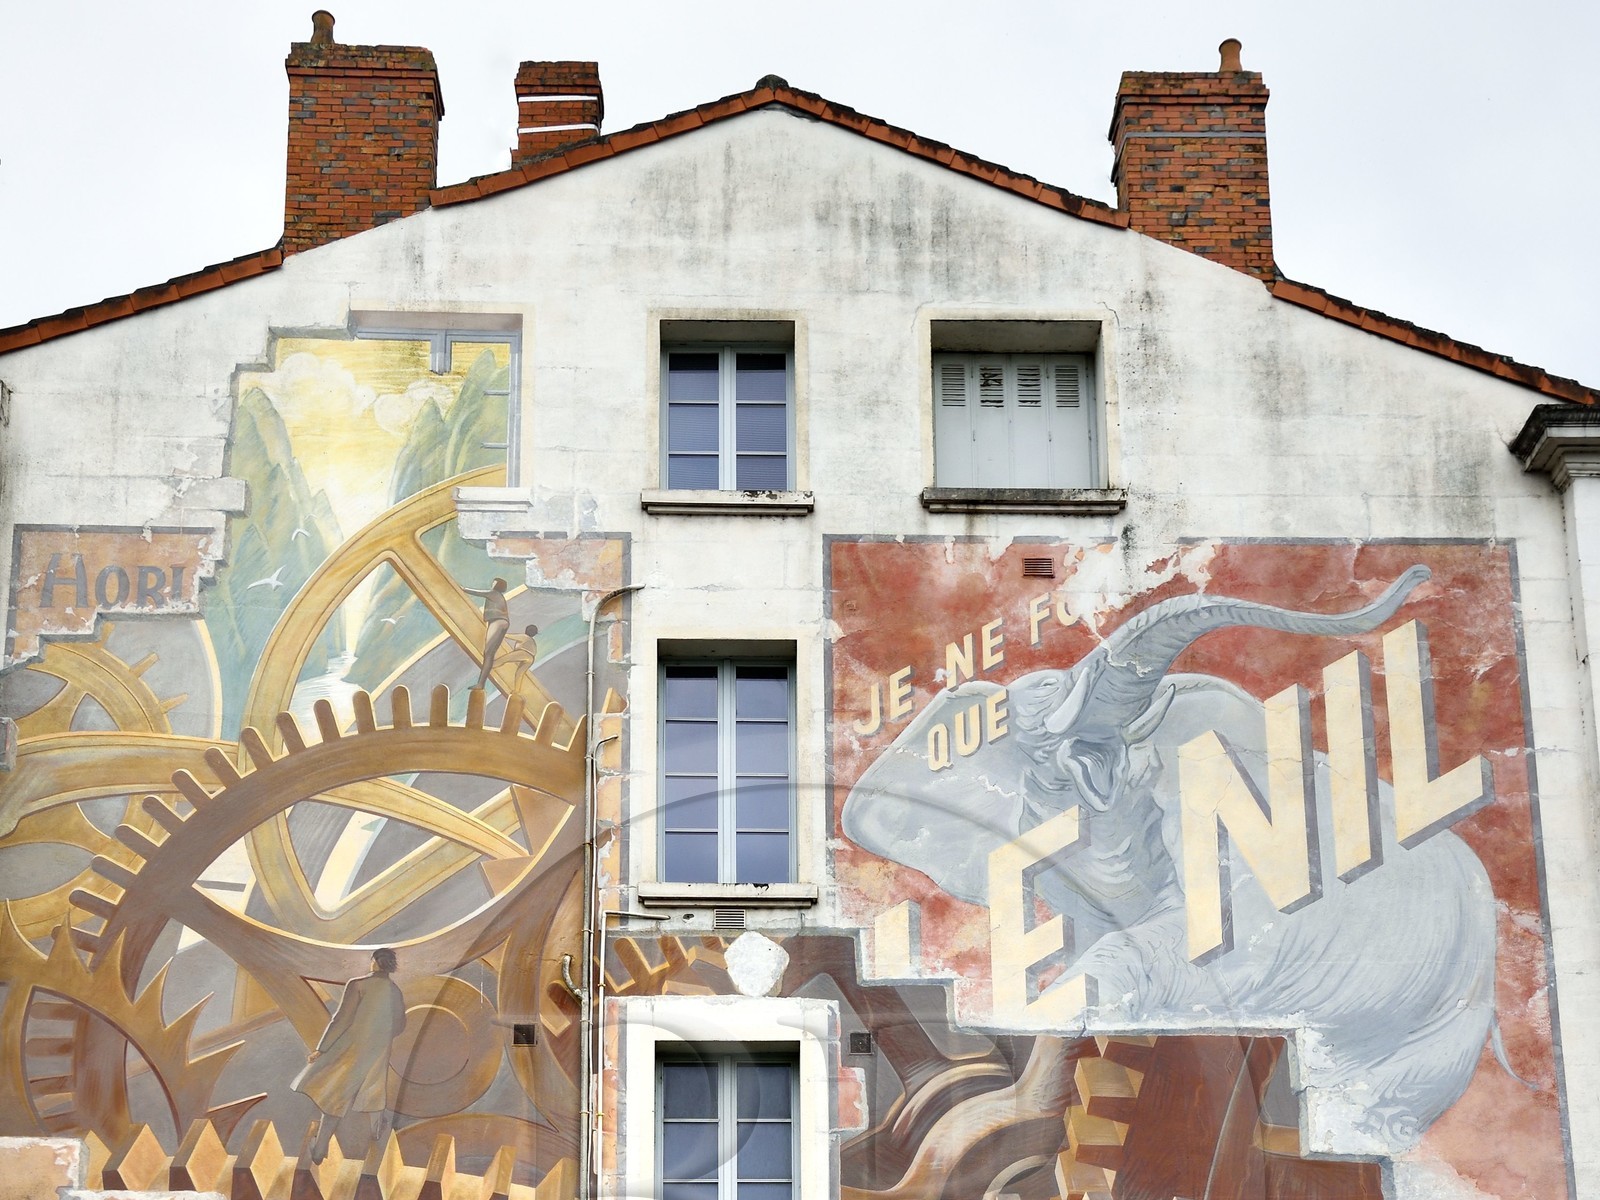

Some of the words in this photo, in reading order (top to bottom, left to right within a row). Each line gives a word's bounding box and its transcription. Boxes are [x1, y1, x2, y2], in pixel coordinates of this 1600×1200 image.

[853, 665, 914, 736] JE
[945, 617, 1006, 692] NE
[927, 688, 1010, 772] QUE
[1178, 618, 1496, 968] NIL
